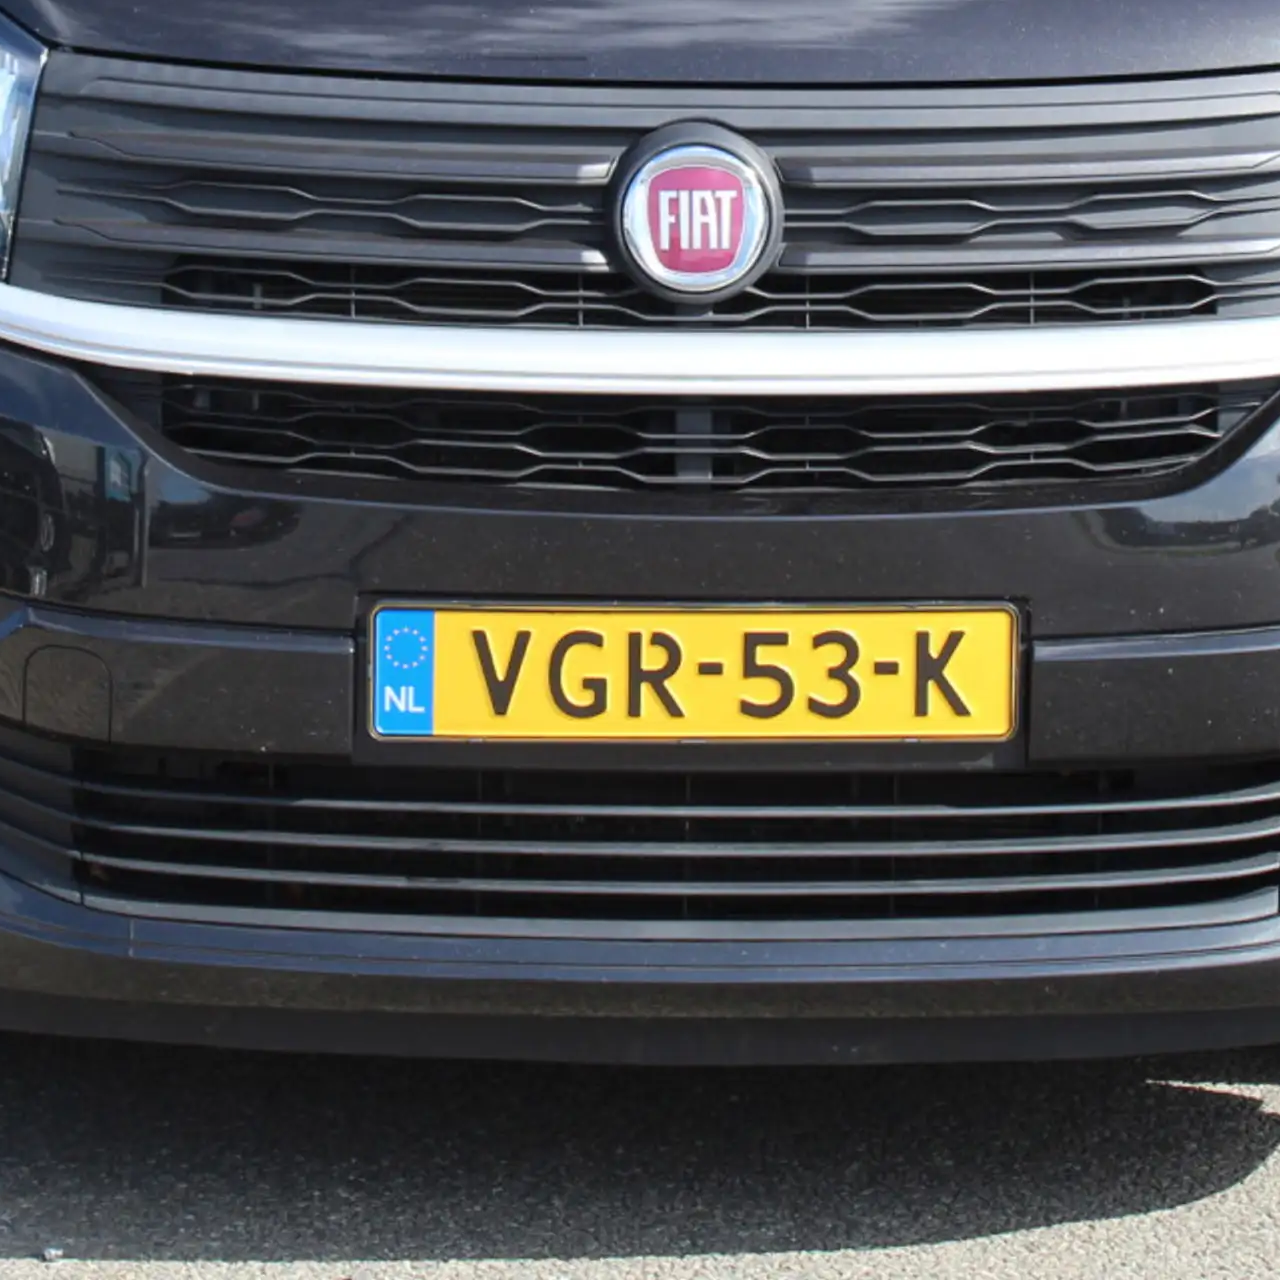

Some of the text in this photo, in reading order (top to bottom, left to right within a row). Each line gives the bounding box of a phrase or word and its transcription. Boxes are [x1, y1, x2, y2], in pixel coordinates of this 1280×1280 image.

[658, 189, 737, 250] FIAT
[383, 685, 426, 713] NL
[471, 629, 971, 719] VGR-53-K
